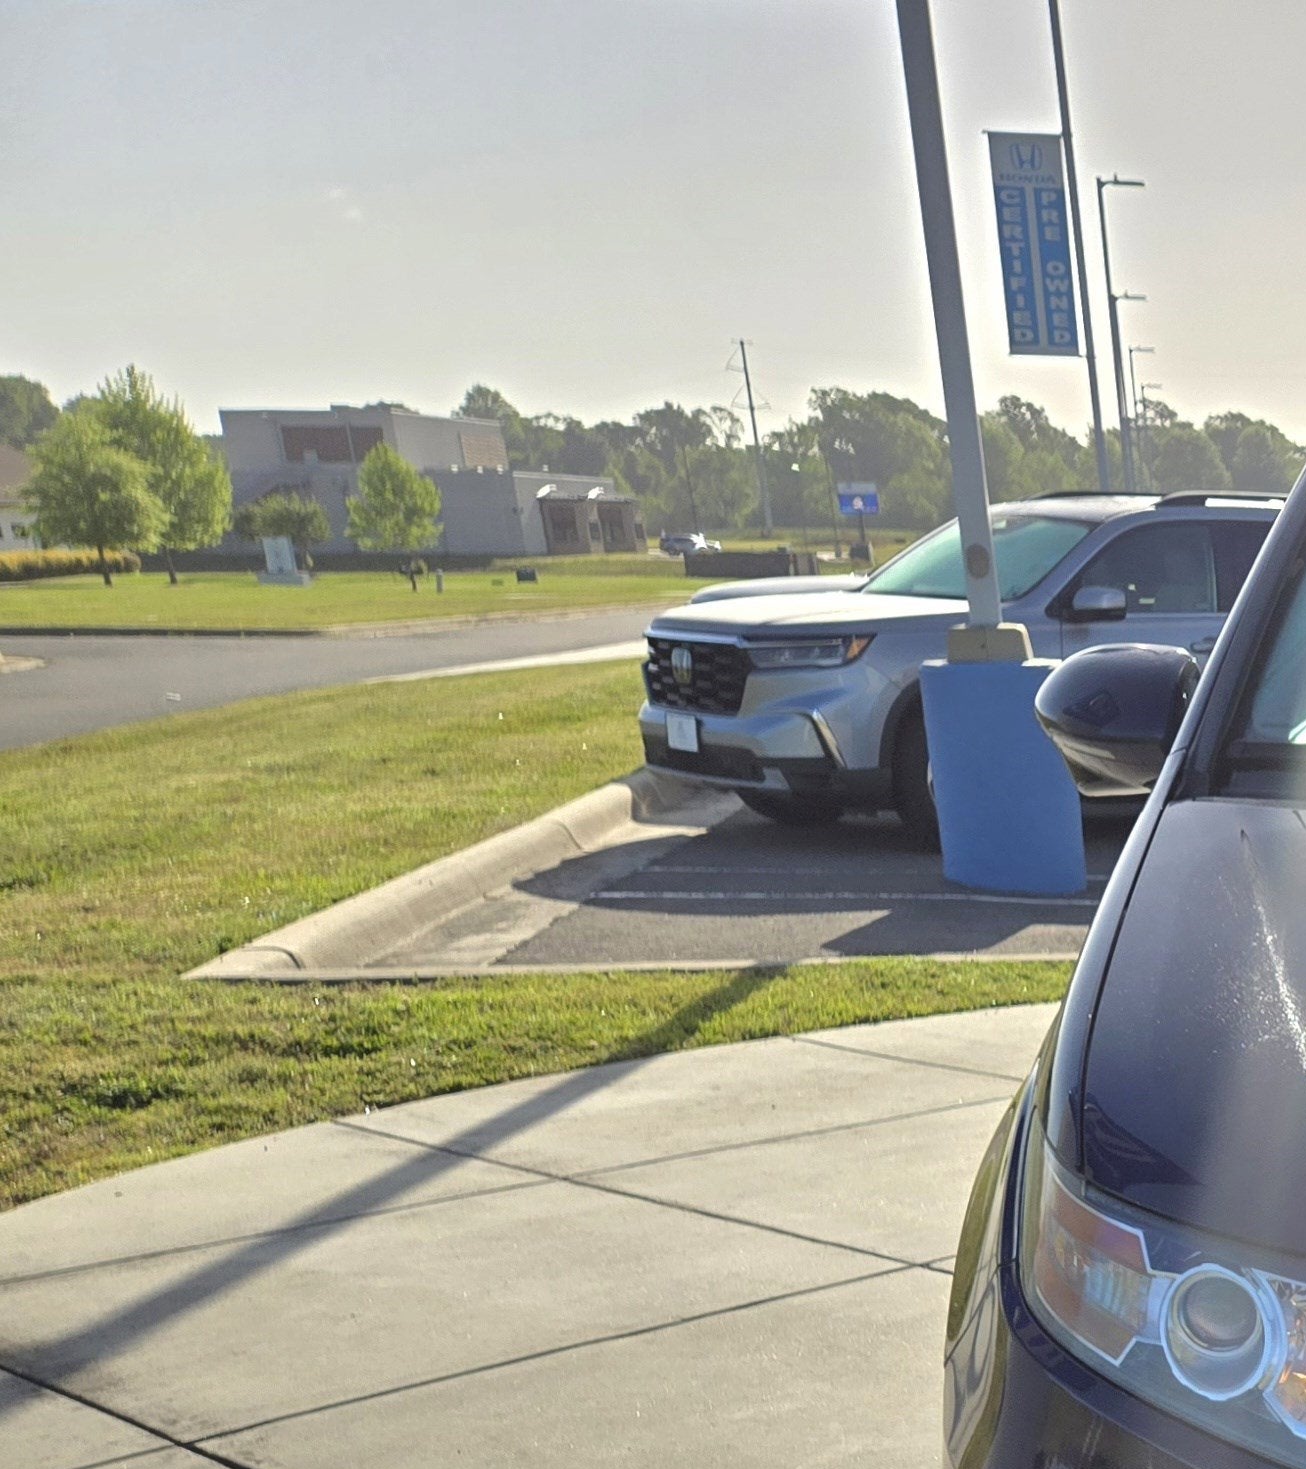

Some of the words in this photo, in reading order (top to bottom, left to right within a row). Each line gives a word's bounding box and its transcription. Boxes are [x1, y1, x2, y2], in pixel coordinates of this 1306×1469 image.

[1040, 190, 1061, 242] PRE
[1000, 189, 1035, 343] CERTIFIED
[1045, 260, 1072, 344] OWNED
